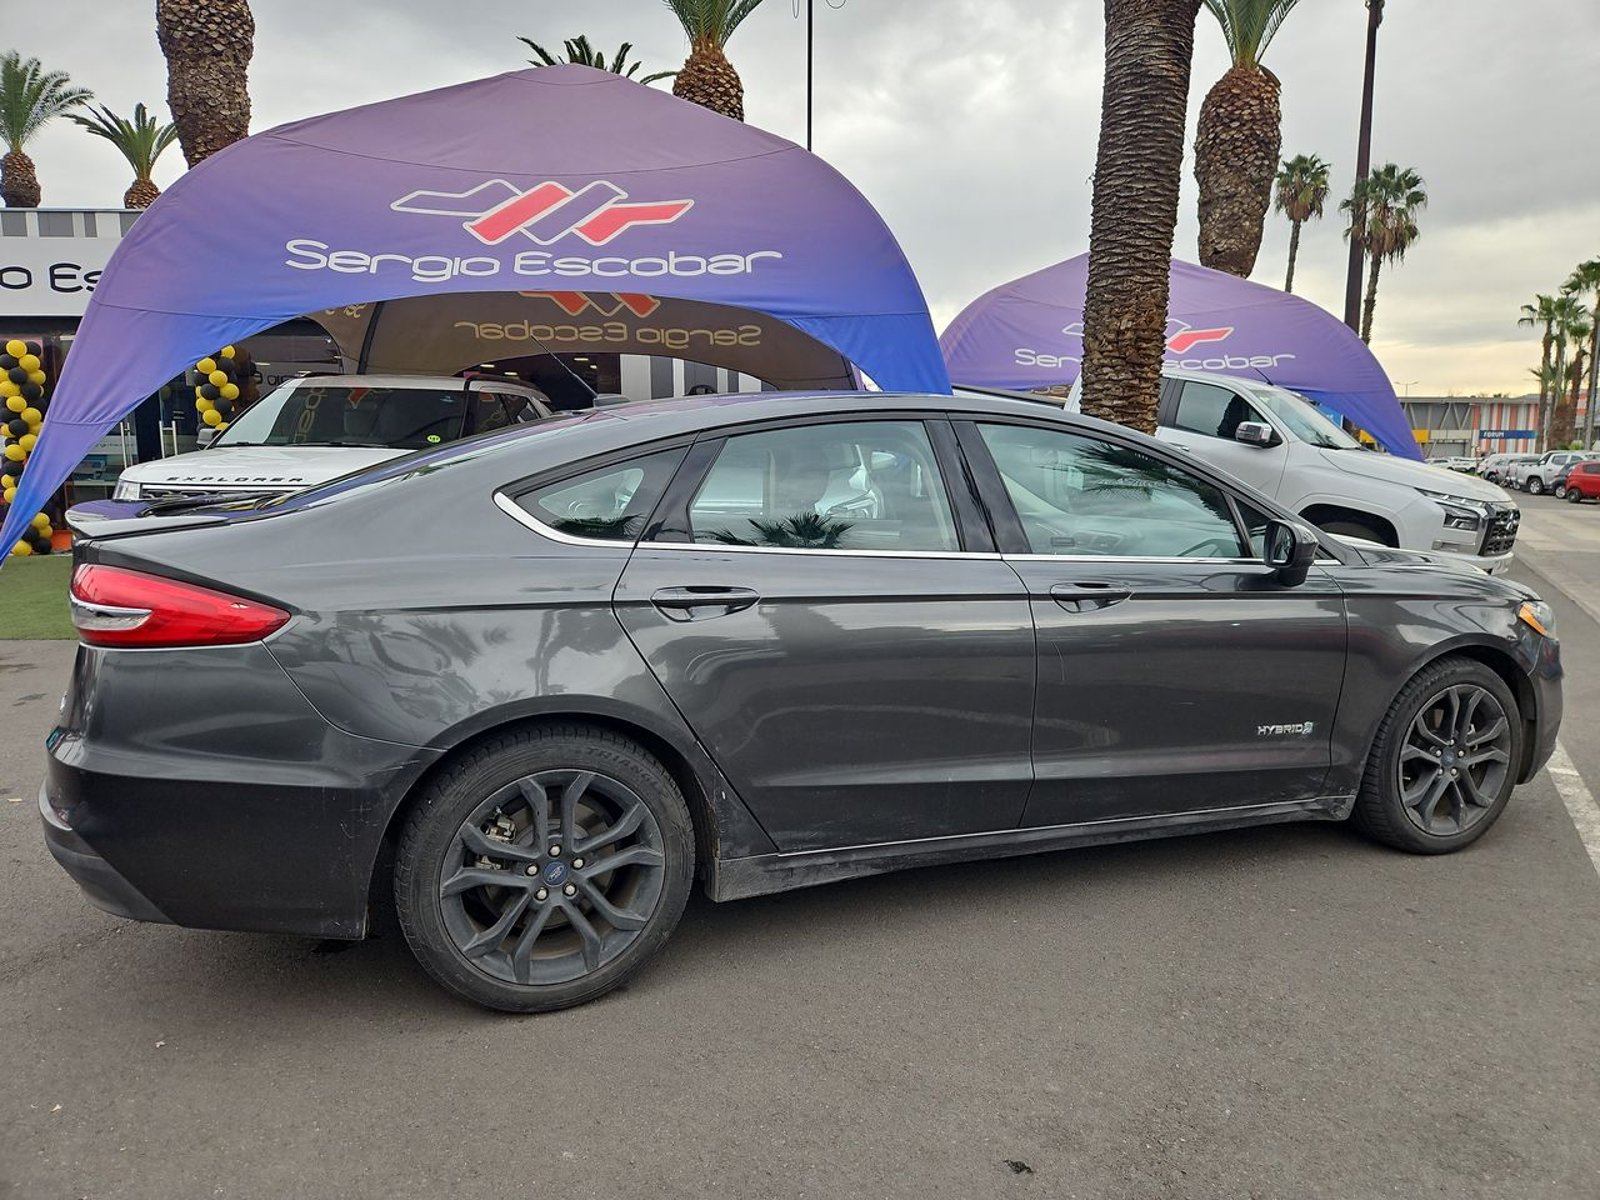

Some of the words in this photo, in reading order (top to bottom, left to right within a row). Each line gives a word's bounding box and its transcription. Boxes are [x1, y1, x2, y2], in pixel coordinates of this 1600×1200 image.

[285, 239, 501, 282] Sergio
[514, 250, 783, 278] Escobar
[1014, 348, 1081, 368] Ser
[1162, 354, 1296, 370] scobar
[1257, 723, 1303, 735] HYBRID
